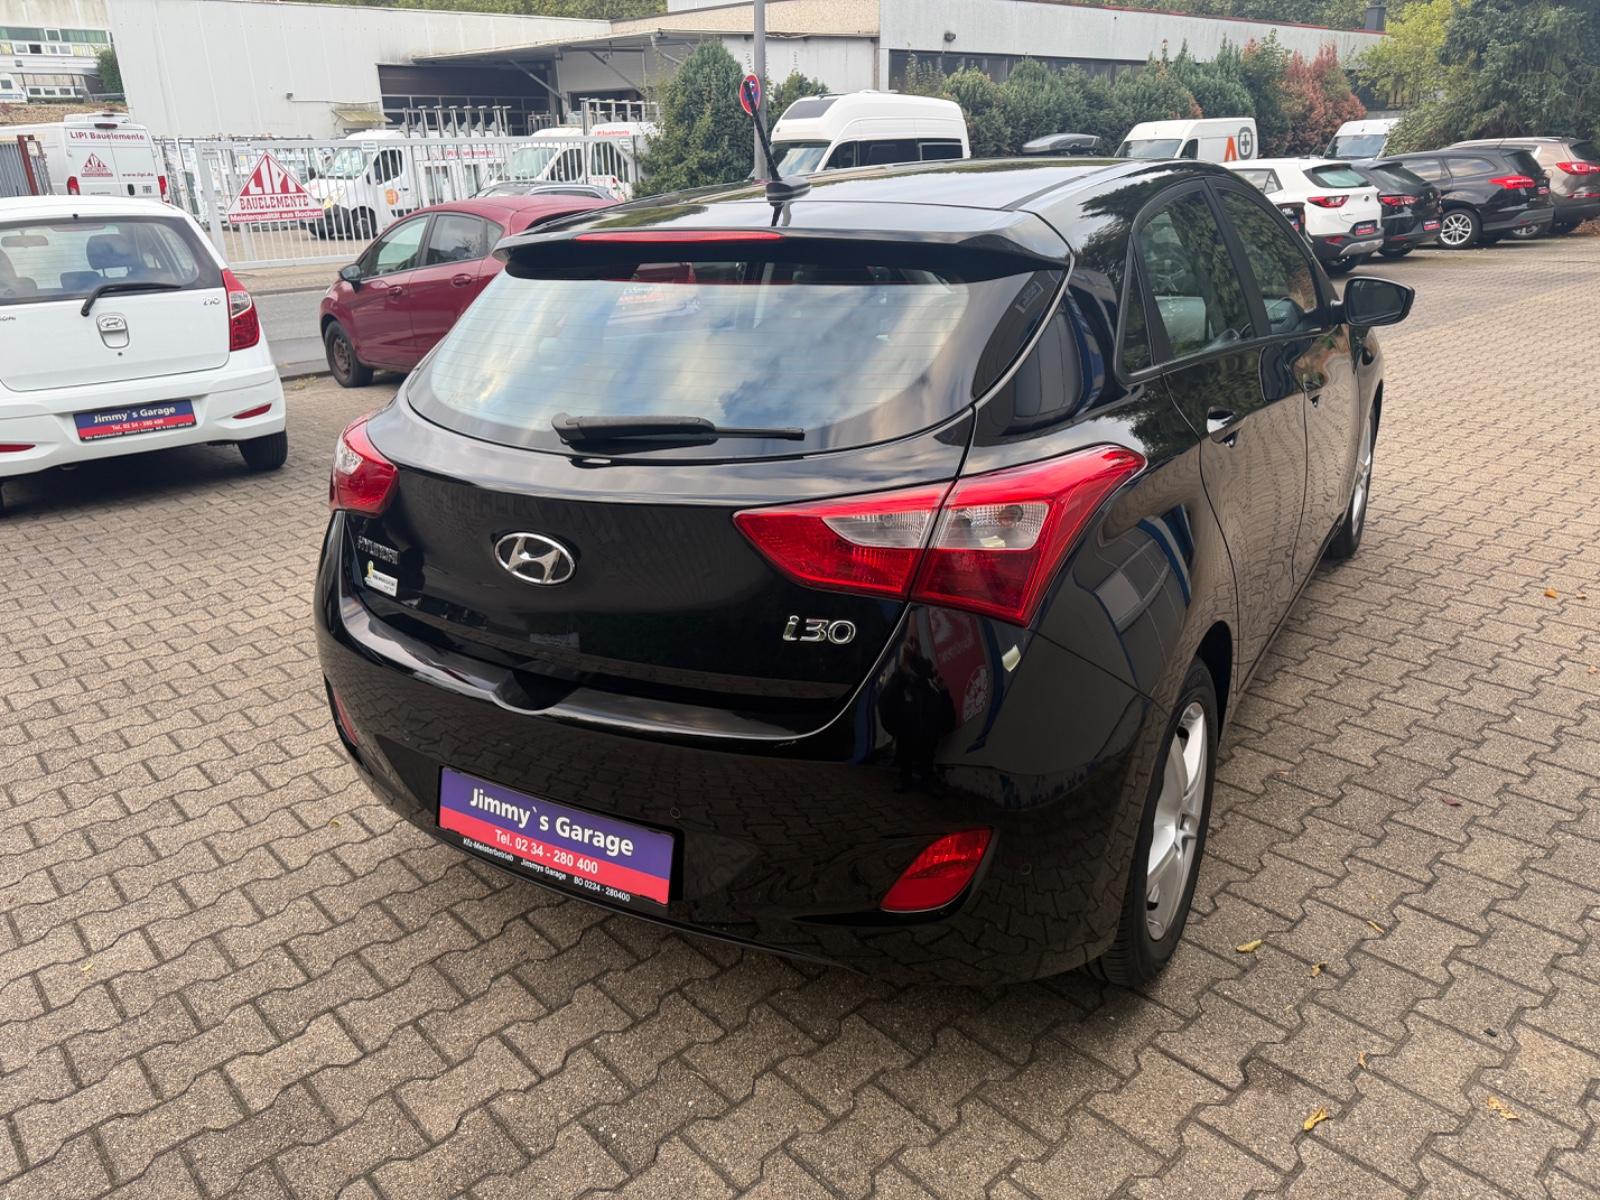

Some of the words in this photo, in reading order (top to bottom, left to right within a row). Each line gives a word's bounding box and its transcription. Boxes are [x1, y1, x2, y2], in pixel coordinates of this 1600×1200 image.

[89, 132, 145, 140] Bauelemente
[247, 157, 298, 195] LIPI
[239, 195, 309, 210] BAUELEMENTE
[140, 406, 176, 418] Garage
[782, 614, 857, 645] i30
[495, 829, 513, 847] Tel.
[515, 837, 529, 852] 02
[530, 842, 544, 857] 34
[553, 849, 574, 867] 280
[576, 858, 598, 875] 400
[555, 816, 634, 857] Garage
[544, 866, 567, 880] Garage
[584, 880, 600, 892] 0234
[605, 887, 631, 902] 280400
